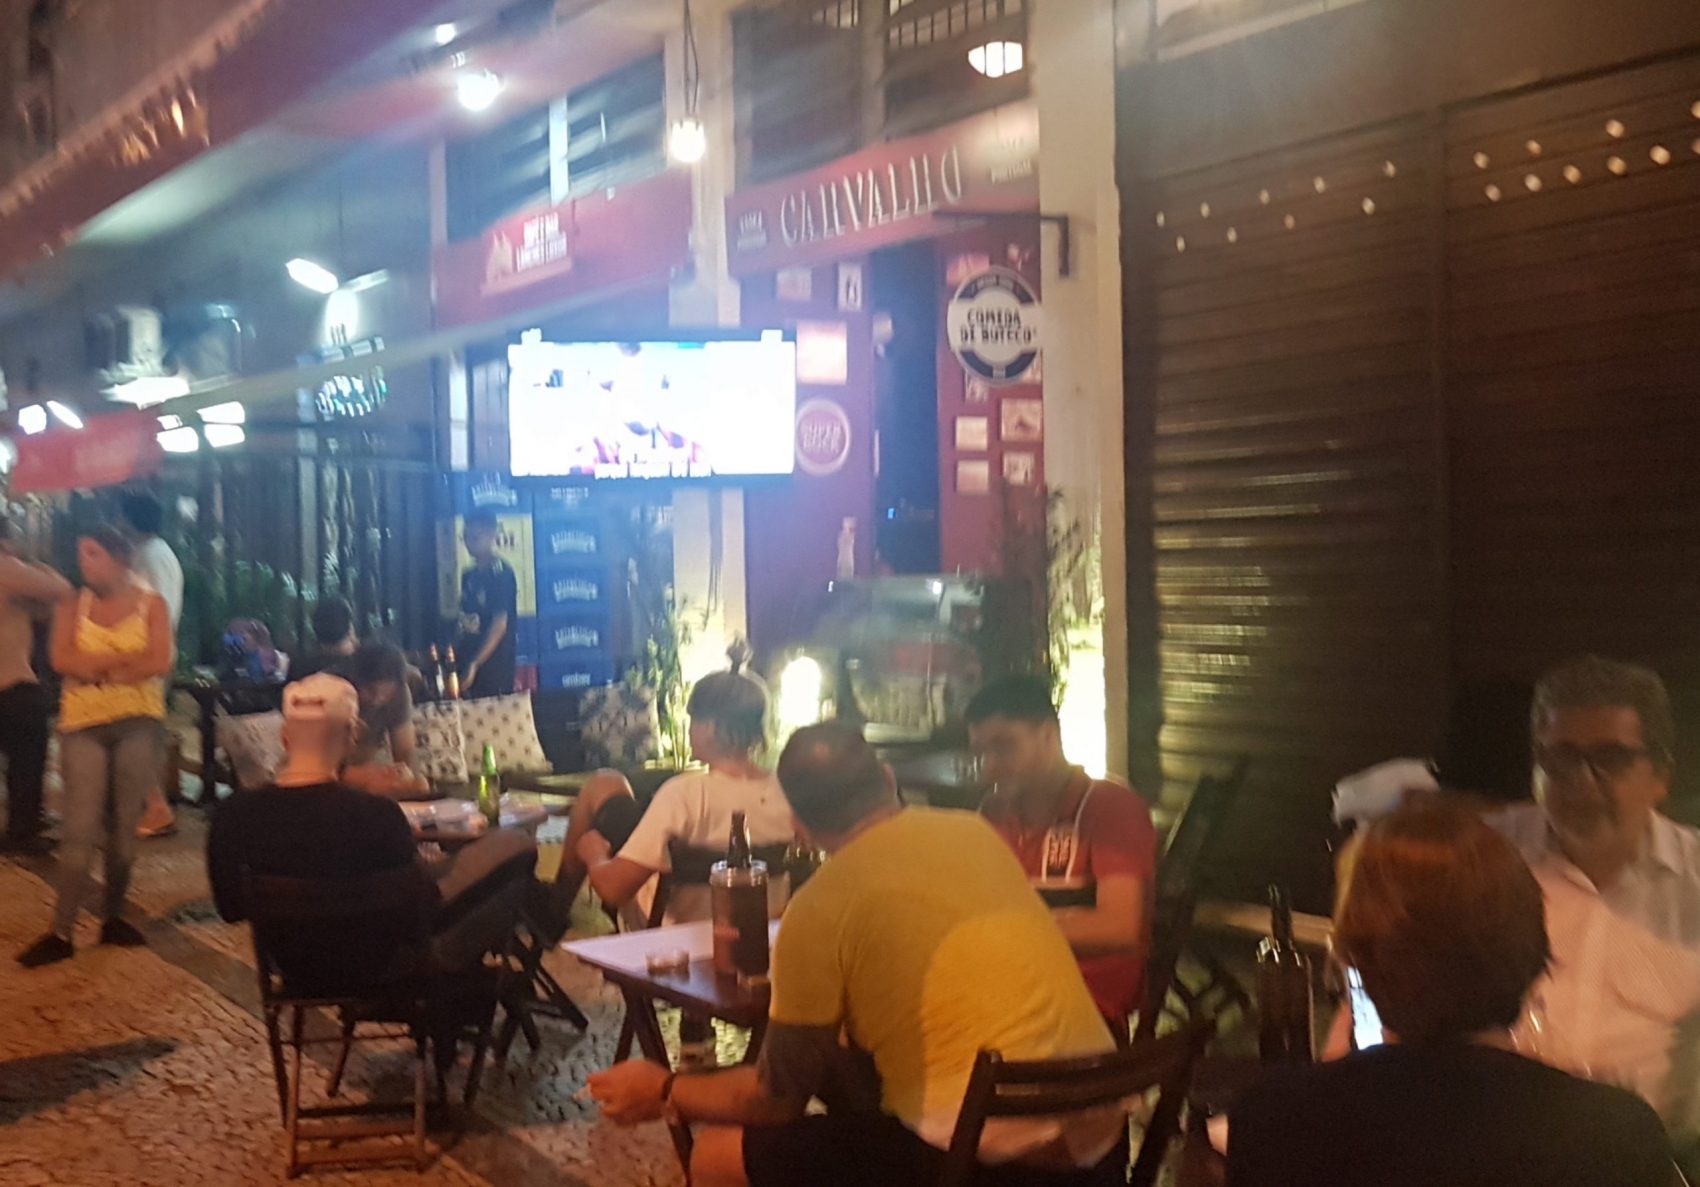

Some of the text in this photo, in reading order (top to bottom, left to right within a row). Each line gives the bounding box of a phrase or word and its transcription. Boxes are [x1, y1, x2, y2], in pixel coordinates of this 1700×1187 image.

[780, 145, 962, 249] CARVALHO
[967, 306, 1021, 327] COMIDA
[981, 325, 1032, 344] BOTECO
